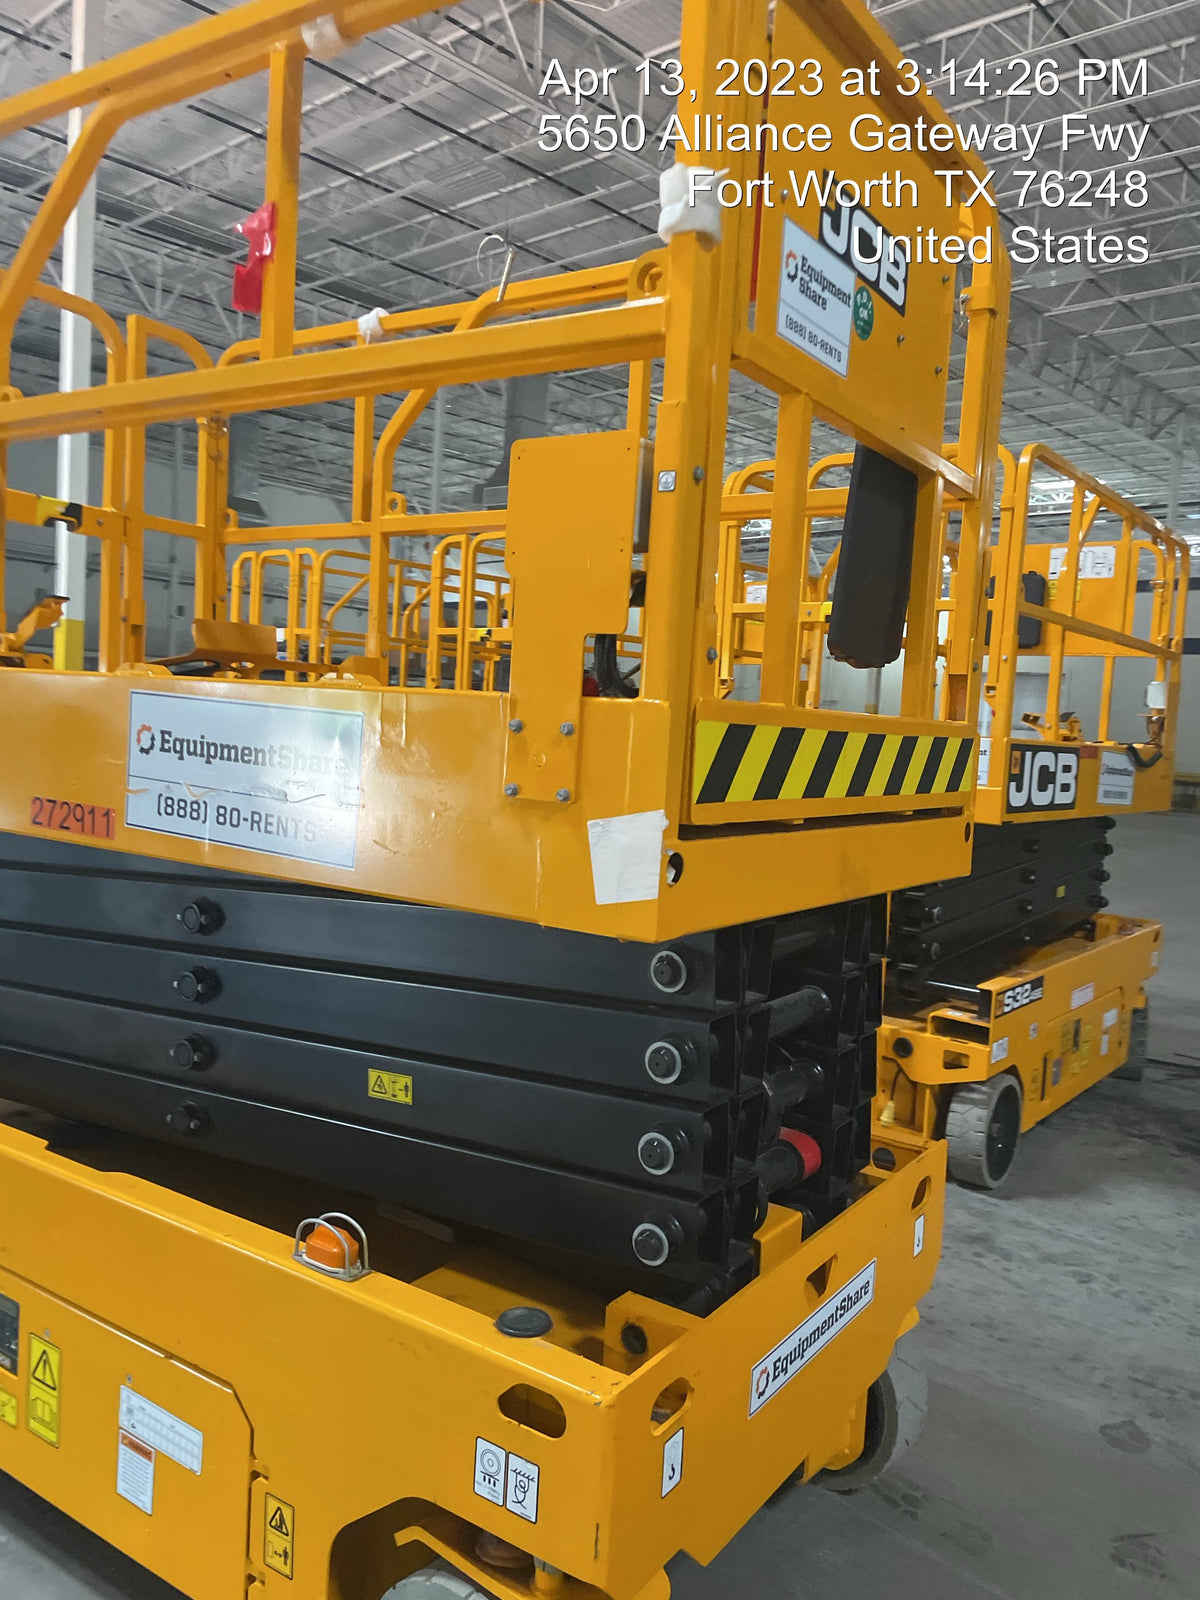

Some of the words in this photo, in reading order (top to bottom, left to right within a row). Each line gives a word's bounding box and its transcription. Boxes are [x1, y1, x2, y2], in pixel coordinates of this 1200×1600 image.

[822, 194, 907, 307] JCB
[799, 277, 828, 311] Share
[800, 255, 852, 309] Equipment
[785, 313, 807, 341] (888)
[808, 331, 842, 363] 80-RENTS
[1009, 750, 1078, 807] JCB
[32, 796, 110, 838] 272911
[157, 793, 208, 825] (888)
[215, 804, 317, 842] 80-RENTS
[771, 1279, 870, 1383] EquipmentShare
